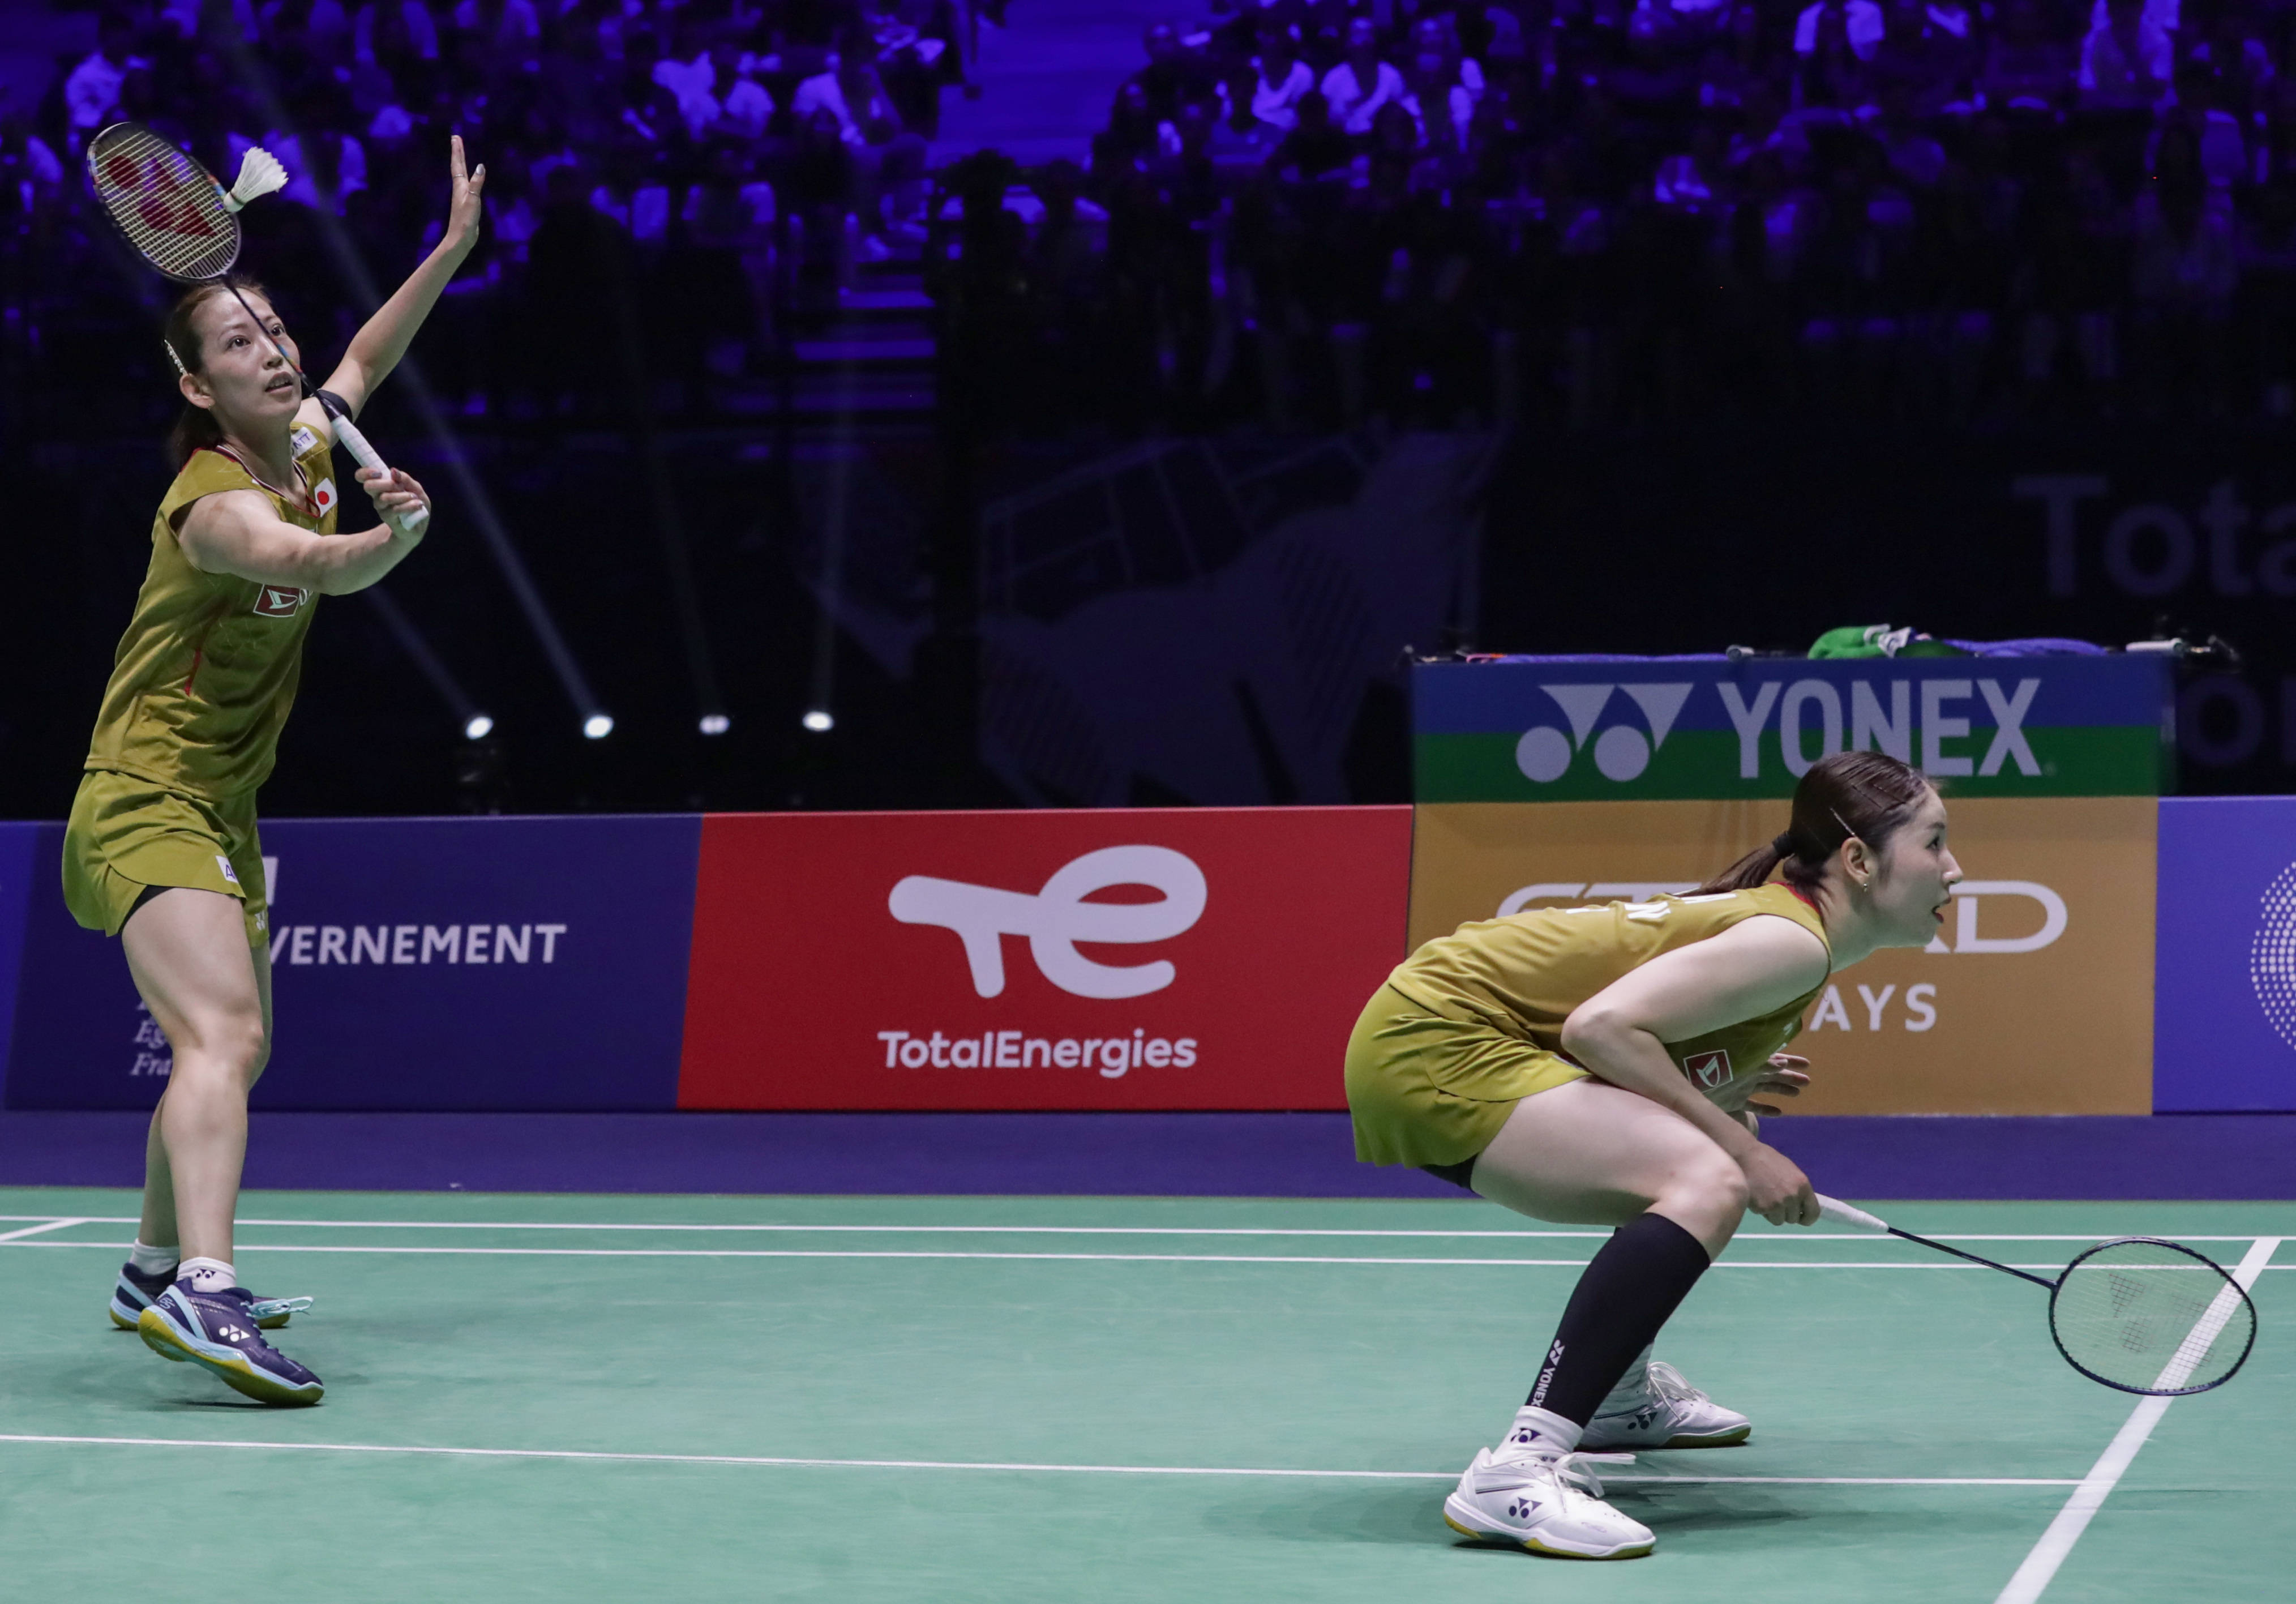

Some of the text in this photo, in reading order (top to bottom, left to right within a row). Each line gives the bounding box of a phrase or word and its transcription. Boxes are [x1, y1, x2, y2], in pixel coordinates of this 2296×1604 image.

[293, 432, 311, 450] NTT
[1716, 678, 2042, 779] YONEX
[877, 1028, 1197, 1078] TotalEnergies
[1531, 1367, 1556, 1407] YONEX
